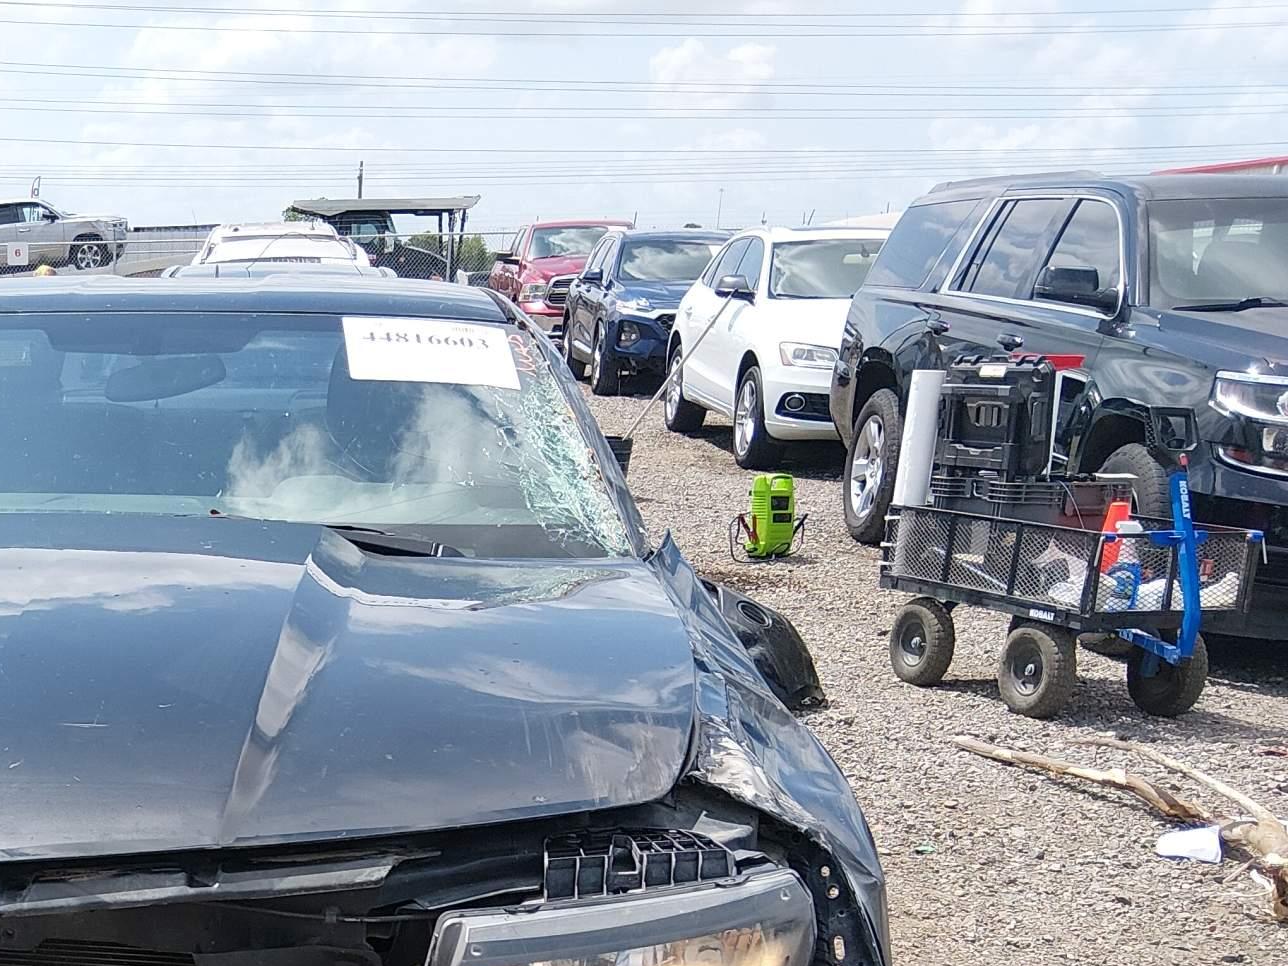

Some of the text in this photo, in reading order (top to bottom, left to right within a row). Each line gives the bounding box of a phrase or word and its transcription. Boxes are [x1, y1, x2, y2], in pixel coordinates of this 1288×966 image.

[14, 248, 21, 257] 6
[362, 331, 489, 349] 44816603
[1179, 480, 1191, 519] KOBALT
[1029, 608, 1055, 620] KOBALT
